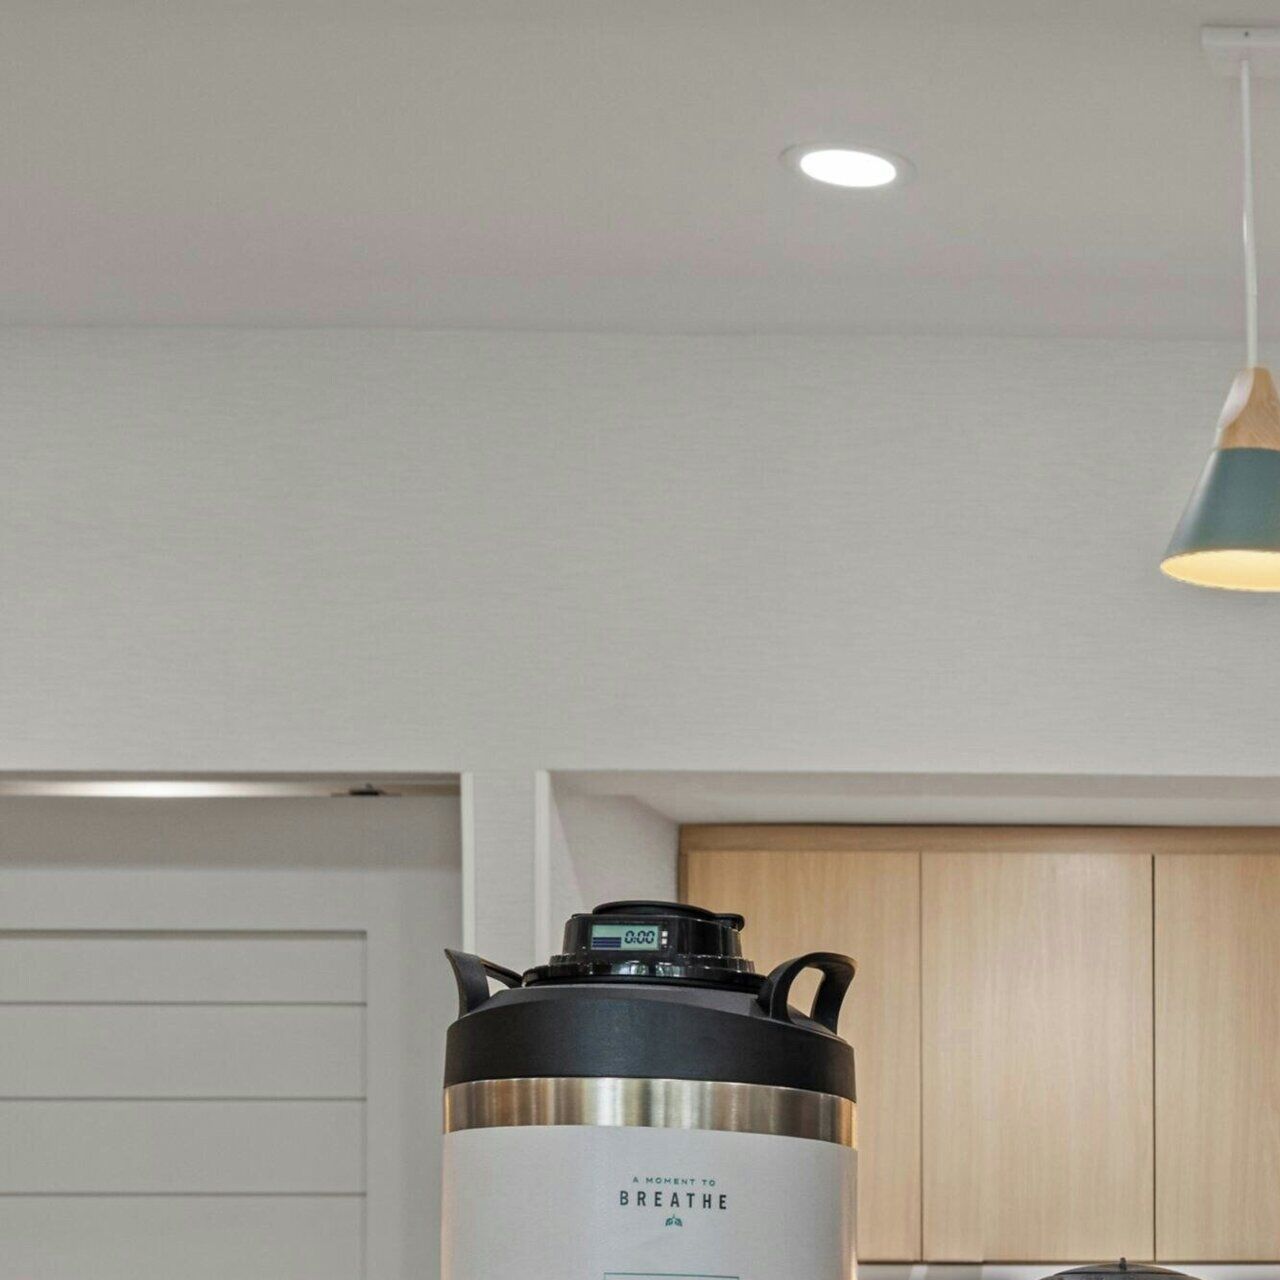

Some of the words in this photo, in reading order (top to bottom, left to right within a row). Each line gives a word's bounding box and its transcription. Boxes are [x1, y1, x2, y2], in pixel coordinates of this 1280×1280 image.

[624, 930, 655, 944] 0:00
[632, 1176, 640, 1185] A
[645, 1177, 696, 1187] MOMENT
[702, 1179, 716, 1187] TO
[619, 1189, 728, 1211] BREATHE
